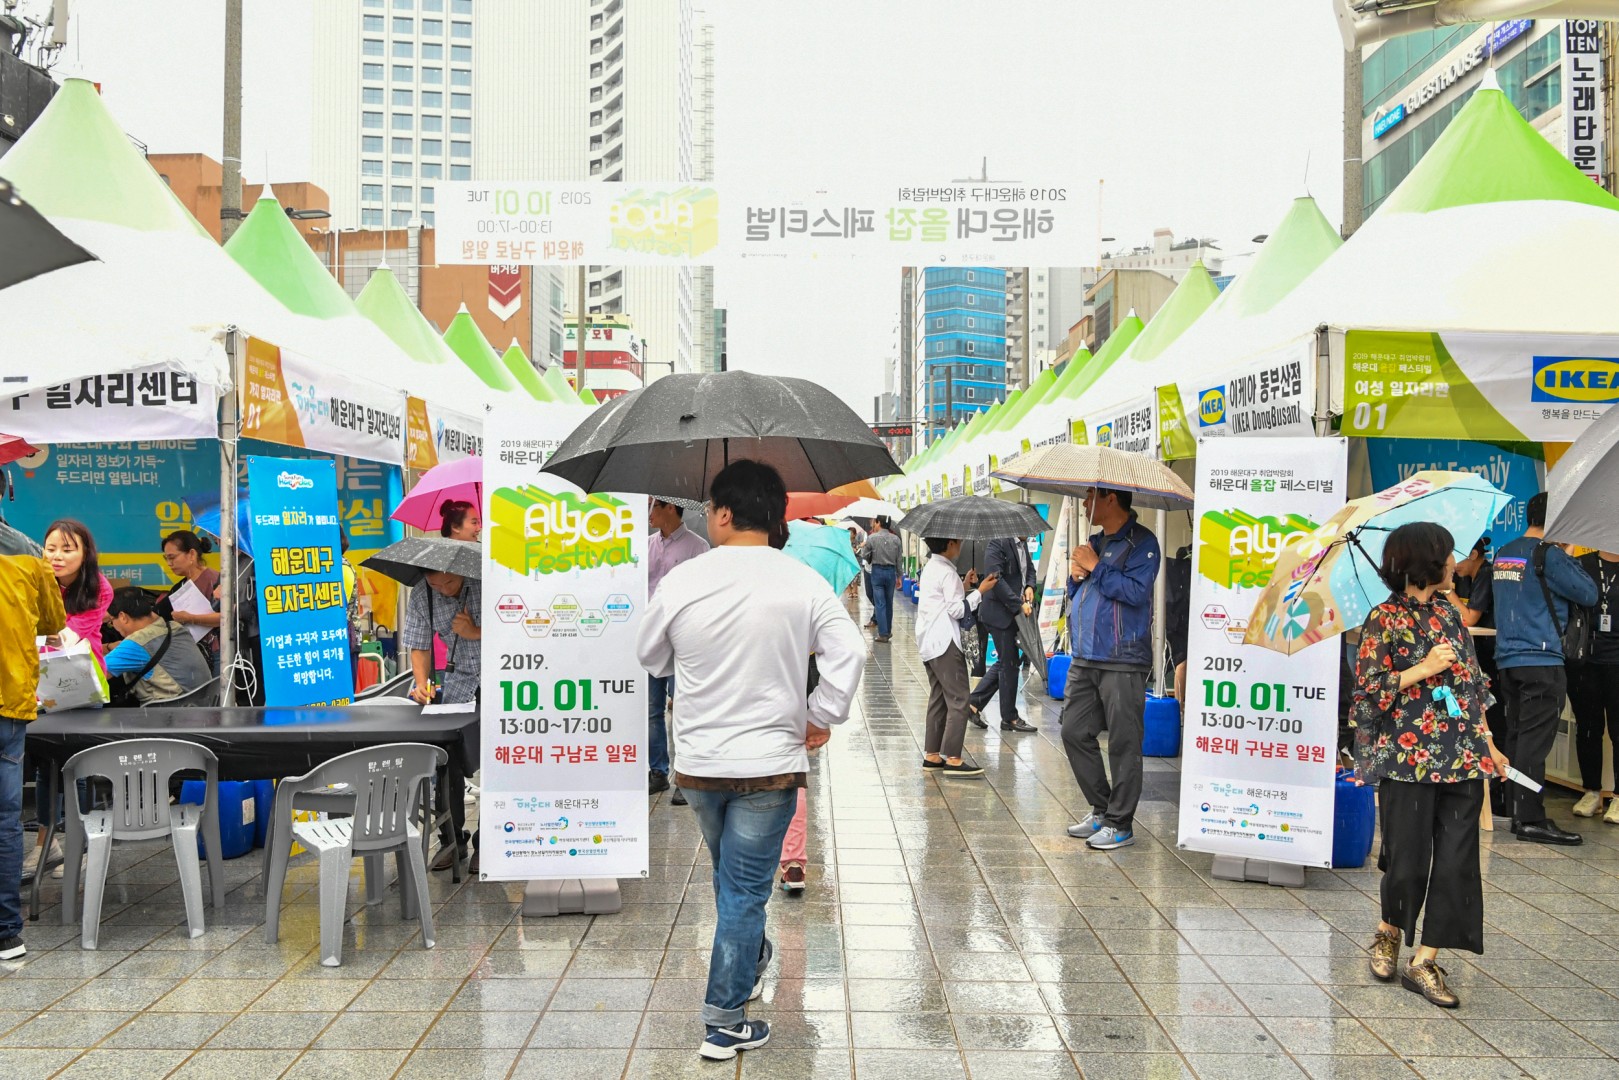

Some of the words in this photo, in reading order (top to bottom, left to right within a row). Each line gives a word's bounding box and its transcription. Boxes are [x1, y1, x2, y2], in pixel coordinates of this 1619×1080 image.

[1567, 20, 1598, 34] TOP
[1568, 36, 1598, 51] TEN
[1406, 44, 1483, 114] GUESTHOUSE
[1572, 57, 1598, 170] 노래타운
[490, 264, 520, 275] 버거킹
[1370, 353, 1397, 361] 해운대구
[1399, 354, 1431, 362] 취업박람회
[1352, 362, 1378, 372] 해운대
[1398, 364, 1432, 374] 페스티벌
[47, 371, 198, 409] 일자리센터
[1230, 374, 1256, 409] 이케아
[1260, 361, 1301, 404] 동부산점
[1354, 380, 1385, 397] 여성
[1390, 380, 1450, 398] 일자리관
[331, 397, 364, 432] 해운대구
[1201, 397, 1224, 416] IKEA
[1542, 408, 1571, 420] 행복을
[1573, 408, 1601, 421] 만드는
[247, 403, 261, 430] 01
[1114, 415, 1129, 439] 이케아
[1130, 407, 1151, 435] 동부산점
[1232, 412, 1251, 436] (IKEA
[1353, 401, 1388, 431] 01
[500, 440, 521, 448] 2019
[523, 440, 553, 449] 해운대구
[56, 454, 92, 468] 일자리
[96, 455, 131, 469] 정보가
[500, 450, 543, 466] 해운대
[56, 471, 106, 485] 두드리면
[108, 471, 158, 485] 열립니다!
[1230, 469, 1258, 477] 해운대구
[1260, 469, 1294, 477] 취업박람회
[1447, 455, 1510, 491] mily
[1209, 478, 1248, 492] 해운대
[1250, 478, 1276, 492] 올잡
[1280, 479, 1333, 493] 페스티벌
[270, 546, 334, 576] 해운대구
[525, 537, 639, 577] Festival
[120, 568, 142, 581] 센터
[1493, 570, 1521, 581] DVENTURE
[264, 581, 344, 615] 일자리센터
[265, 633, 293, 649] 기업과
[295, 630, 319, 646] 구직자
[321, 627, 348, 642] 모두에게
[277, 654, 302, 670] 든든한
[304, 651, 320, 667] 힘이
[322, 646, 344, 662] 되기를
[500, 653, 548, 671] 2019.
[1204, 656, 1246, 673] 2019.
[293, 668, 334, 685] 희망합니다.
[599, 679, 635, 694] TUE
[1292, 686, 1326, 700] TUE
[500, 717, 612, 735] 13:00~17:00
[1201, 712, 1303, 734] 13:00~17:00
[495, 745, 543, 765] 해운대
[550, 745, 599, 764] 구남로
[605, 744, 637, 763] 일원
[1196, 736, 1238, 755] 해운대
[1245, 740, 1289, 758] 구남로
[1296, 744, 1325, 763] 일원
[1246, 787, 1288, 801] 해운대구청
[493, 800, 506, 809] 주관
[554, 798, 599, 810] 해운대구청
